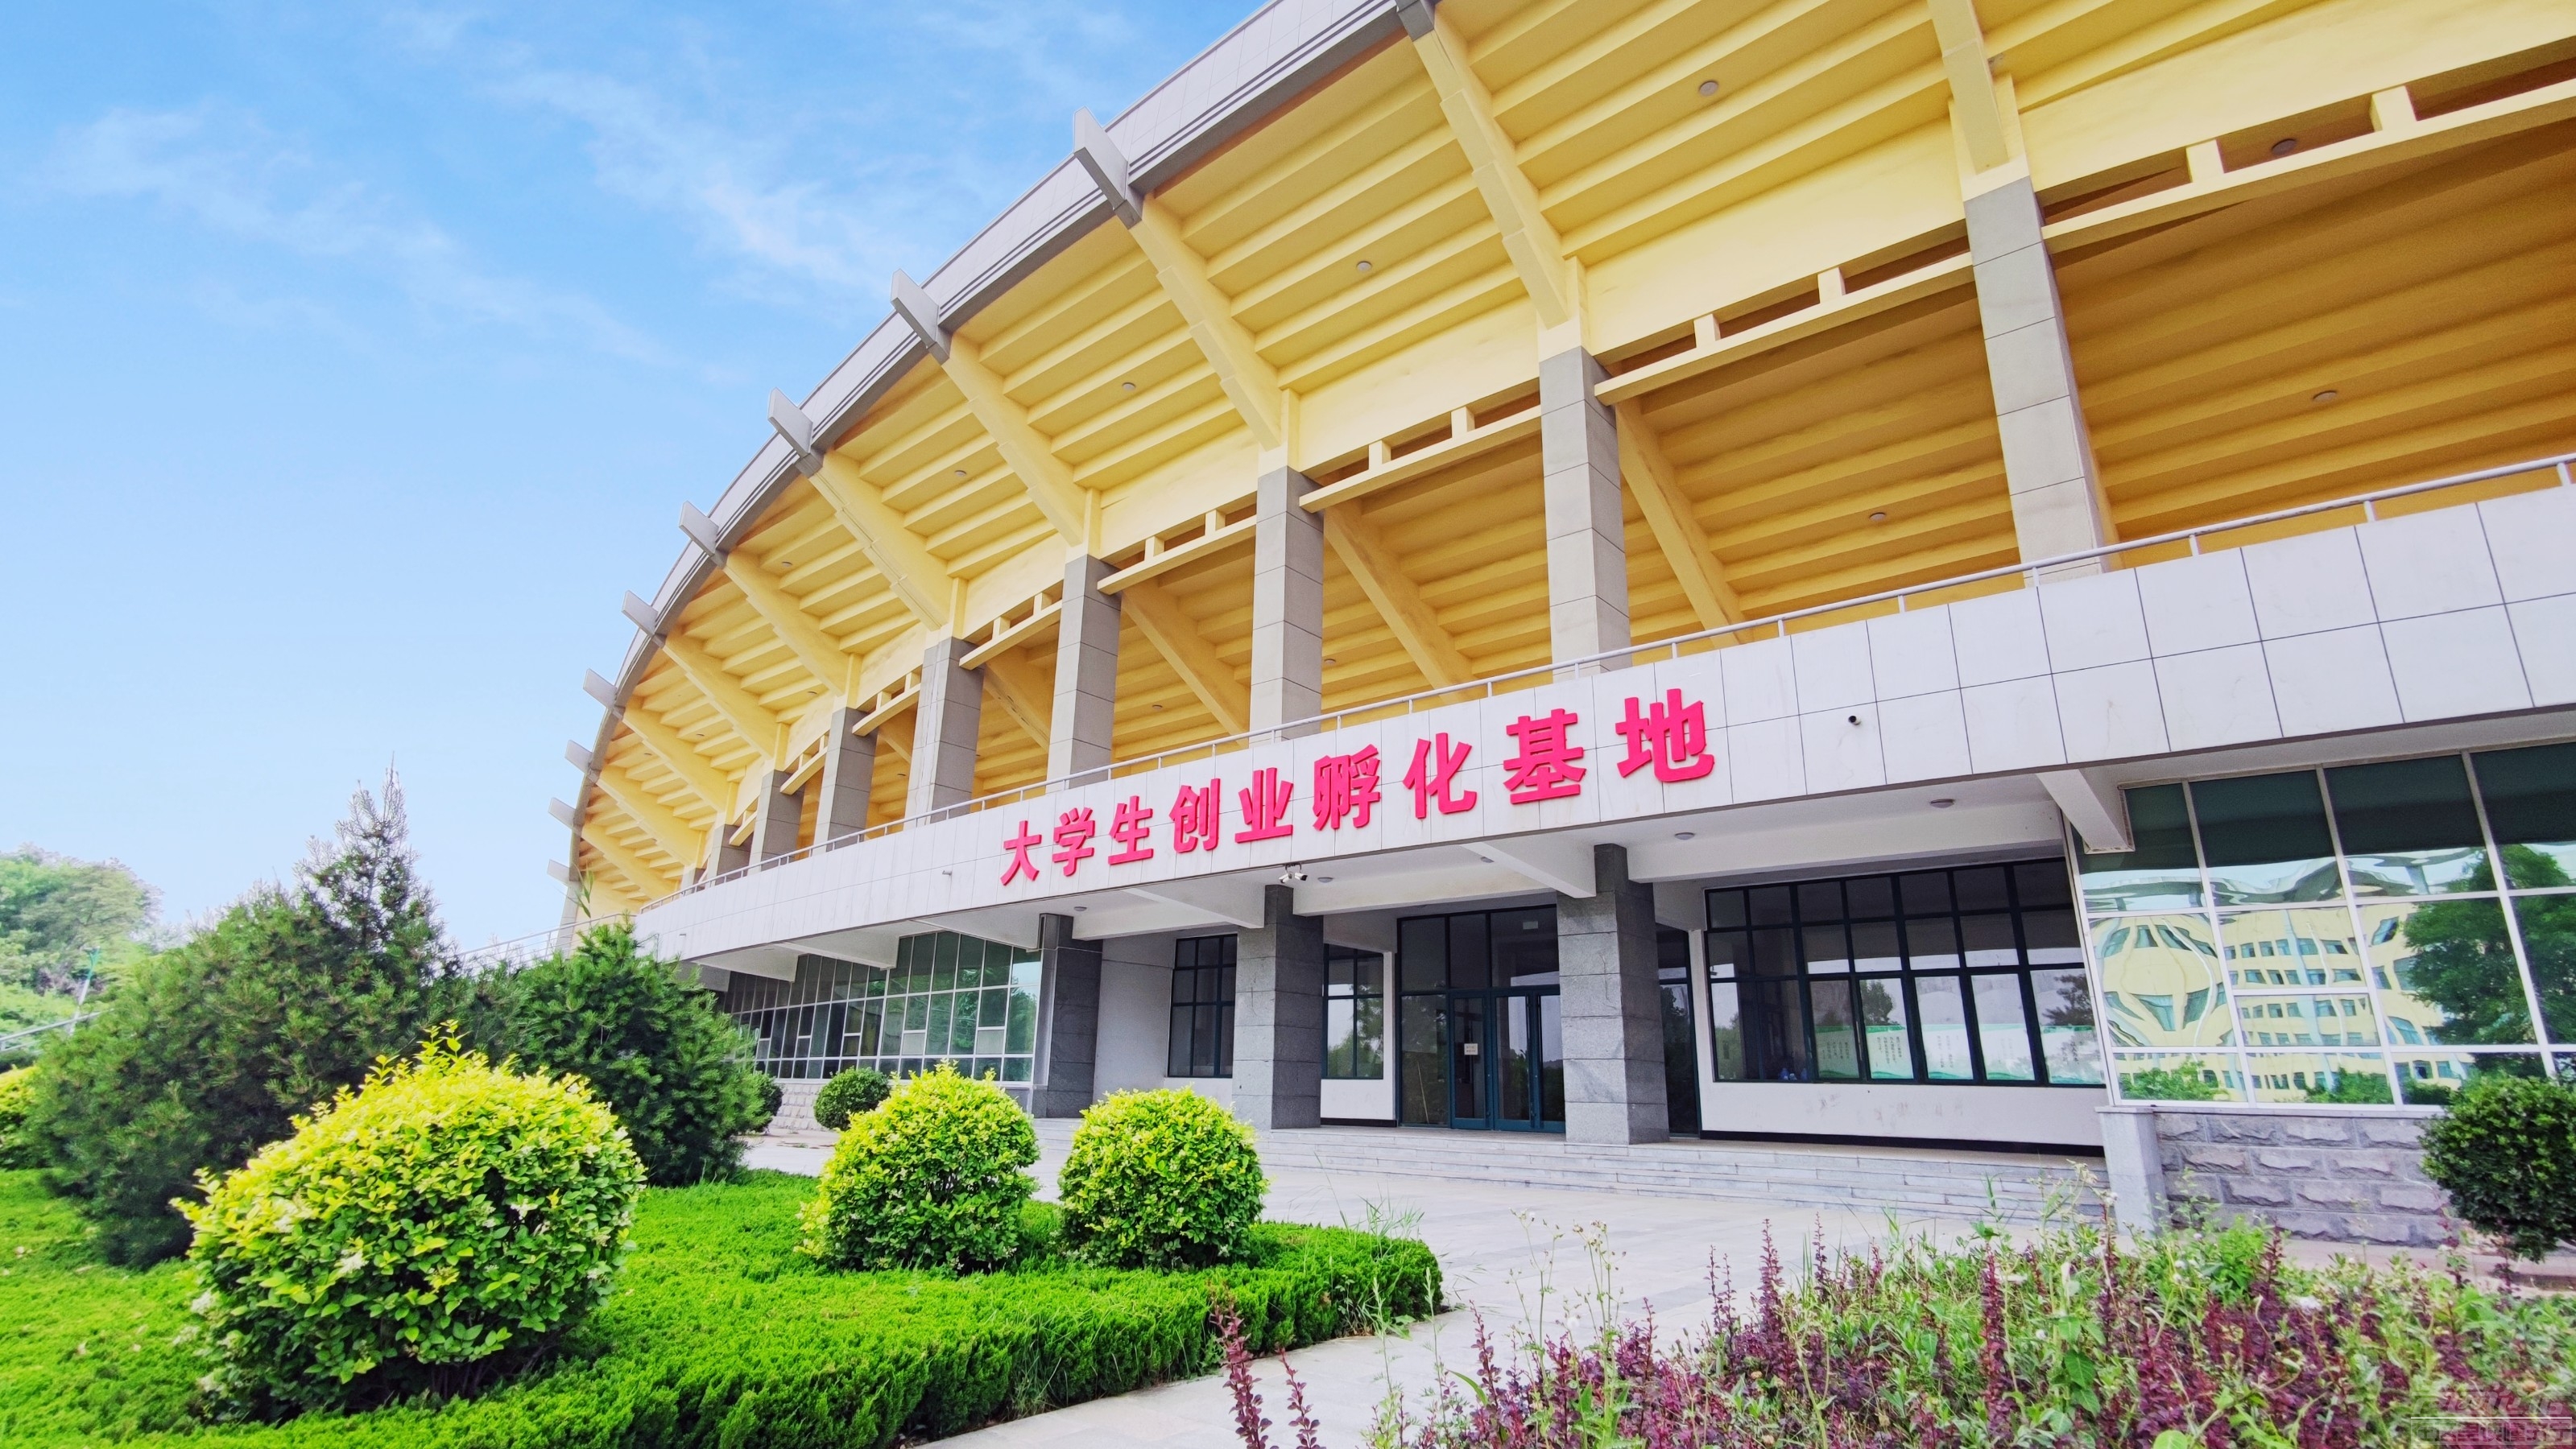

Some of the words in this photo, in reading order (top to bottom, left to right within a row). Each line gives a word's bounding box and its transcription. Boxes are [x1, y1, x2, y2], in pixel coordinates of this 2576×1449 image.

[1000, 687, 1716, 886] 大学生创业孵化基地
